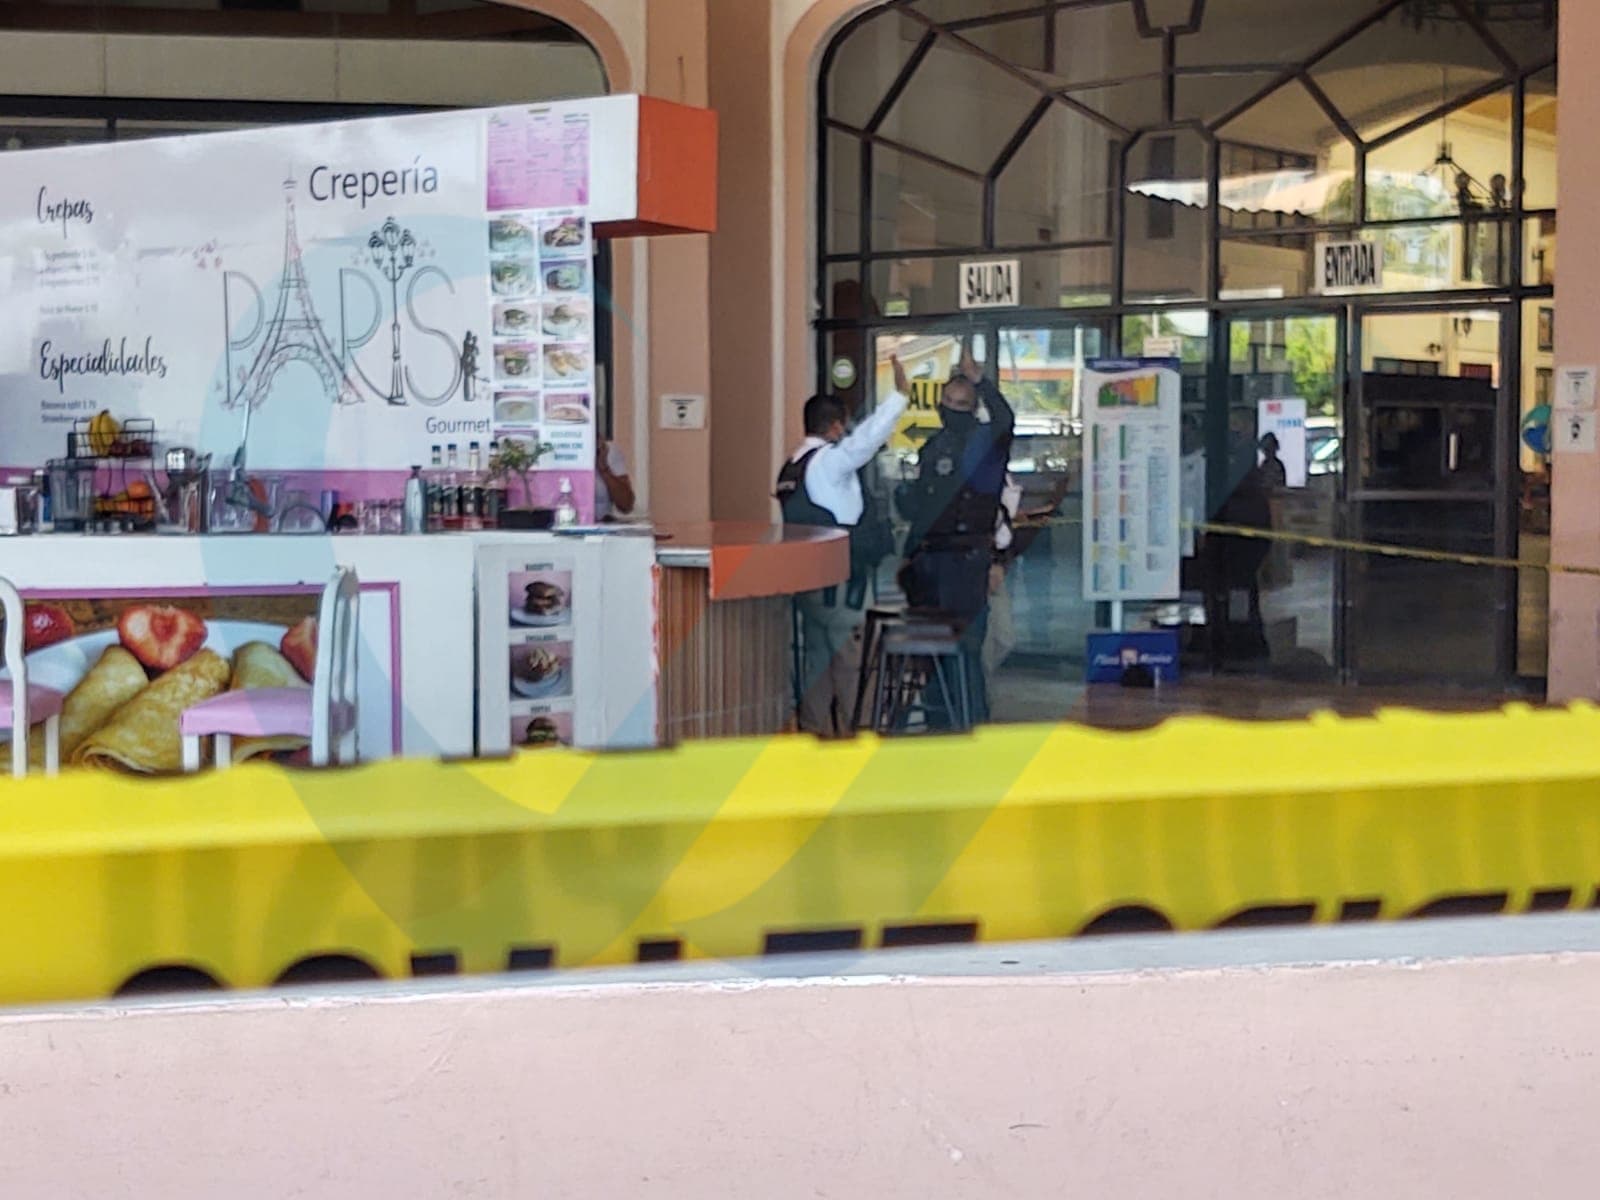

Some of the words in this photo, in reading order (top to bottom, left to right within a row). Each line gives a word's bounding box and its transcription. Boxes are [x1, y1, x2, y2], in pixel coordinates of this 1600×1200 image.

[309, 154, 438, 209] Crepería
[37, 184, 94, 240] Crepas
[967, 263, 1013, 304] SALIDA
[1325, 244, 1376, 287] ENTRADA
[40, 335, 167, 394] Especialidades
[426, 416, 490, 434] Gourmet
